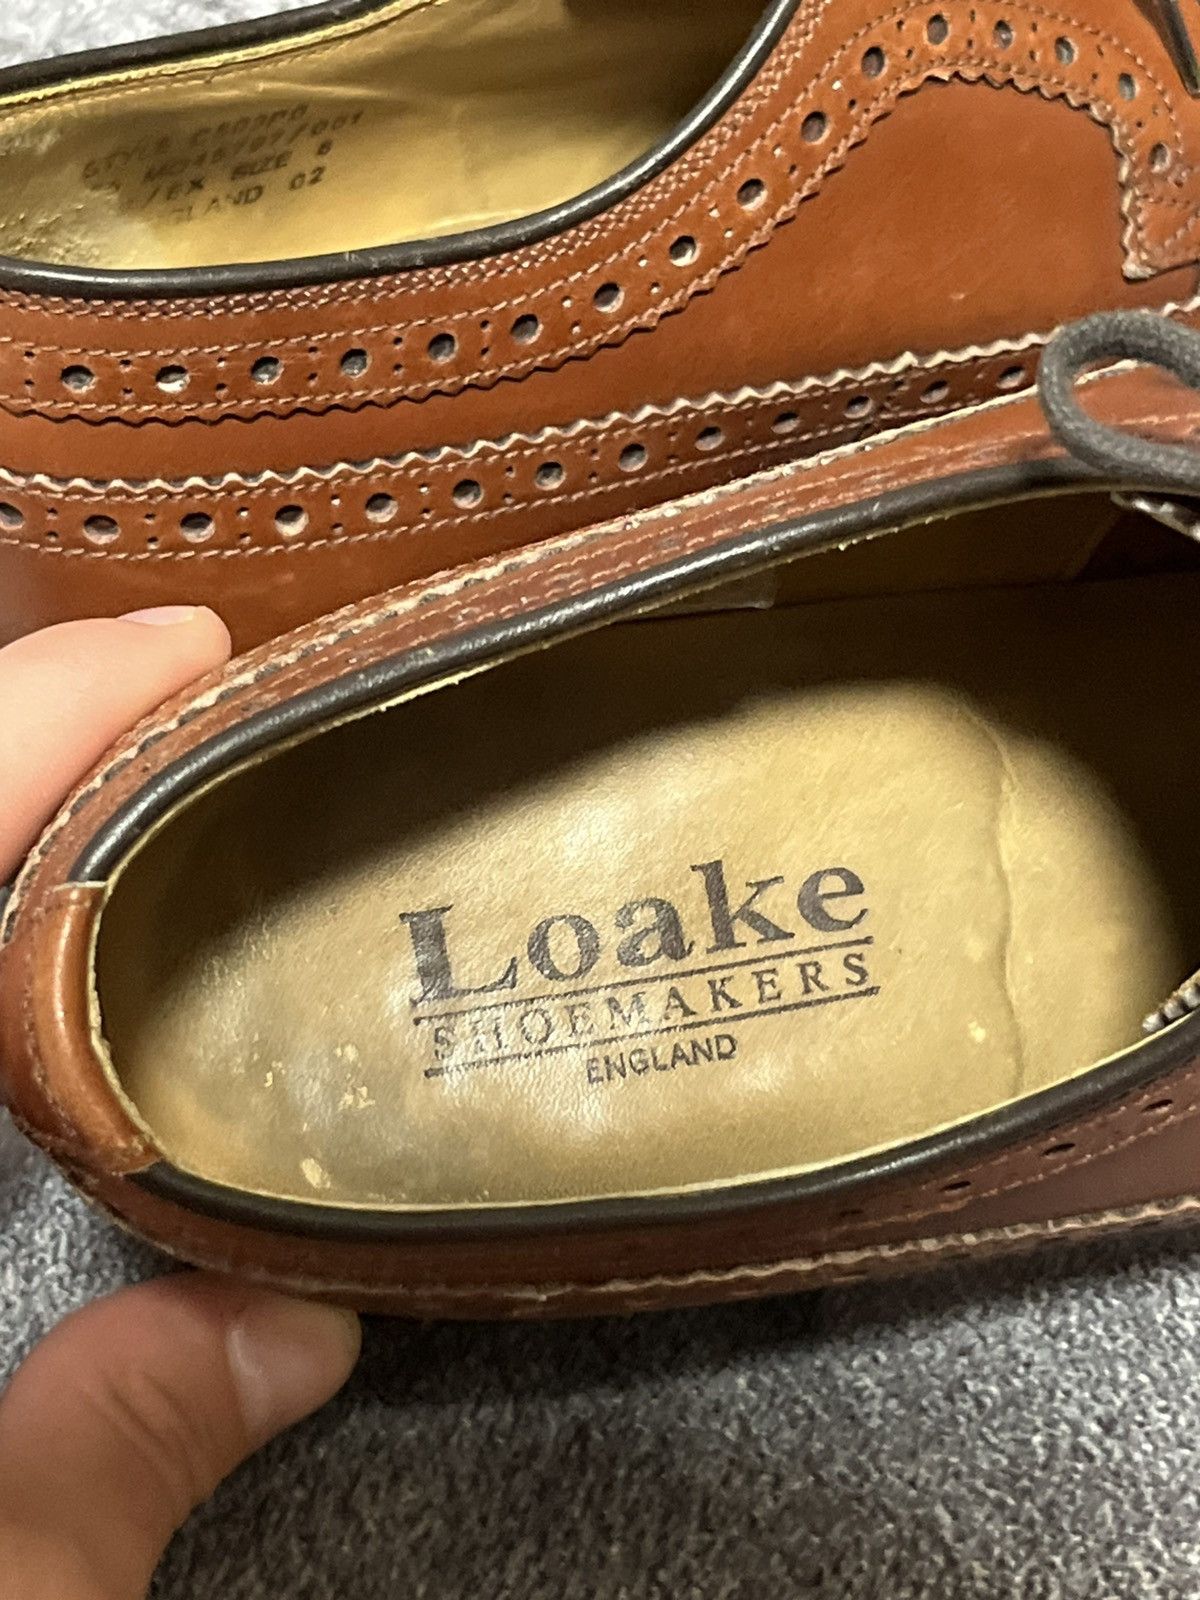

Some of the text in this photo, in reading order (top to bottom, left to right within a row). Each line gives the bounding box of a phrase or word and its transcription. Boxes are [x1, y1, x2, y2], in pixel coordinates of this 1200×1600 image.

[230, 150, 293, 182] SIZE
[288, 166, 327, 191] 02
[399, 858, 869, 1008] Loake
[433, 952, 872, 1062] SHOEMAKERS
[586, 1033, 739, 1085] ENGLAND
